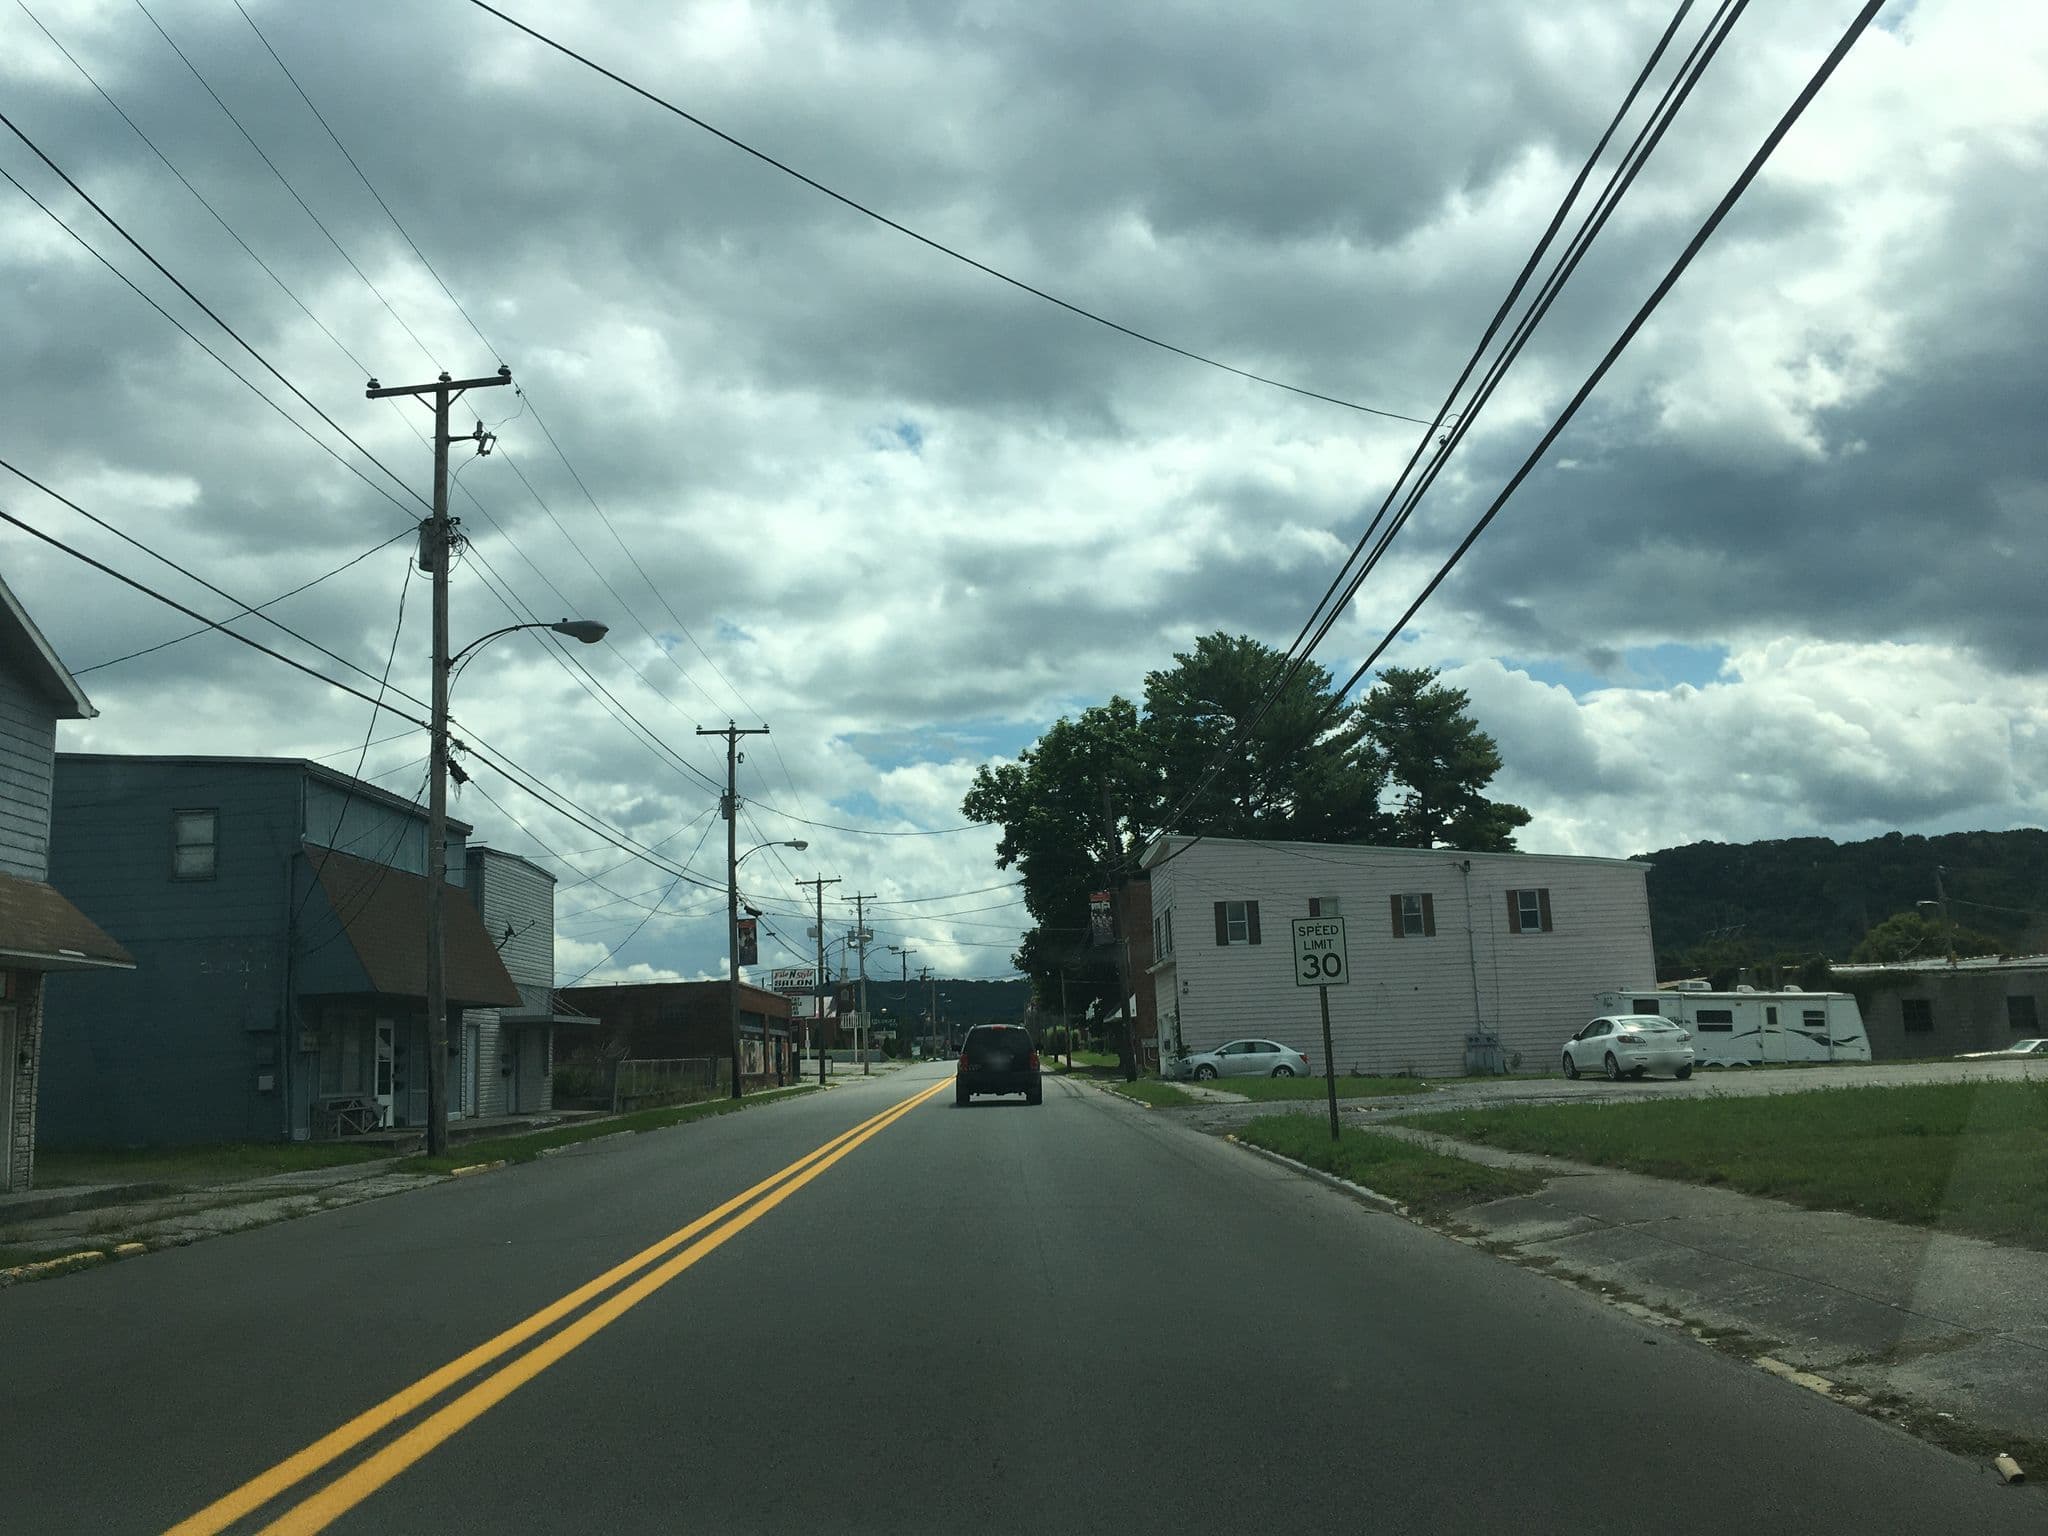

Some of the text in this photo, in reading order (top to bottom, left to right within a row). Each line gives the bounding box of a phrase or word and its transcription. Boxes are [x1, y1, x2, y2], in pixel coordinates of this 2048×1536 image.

[1298, 925, 1339, 936] SPEED
[1303, 939, 1334, 950] LIMIT
[1302, 952, 1342, 979] 30
